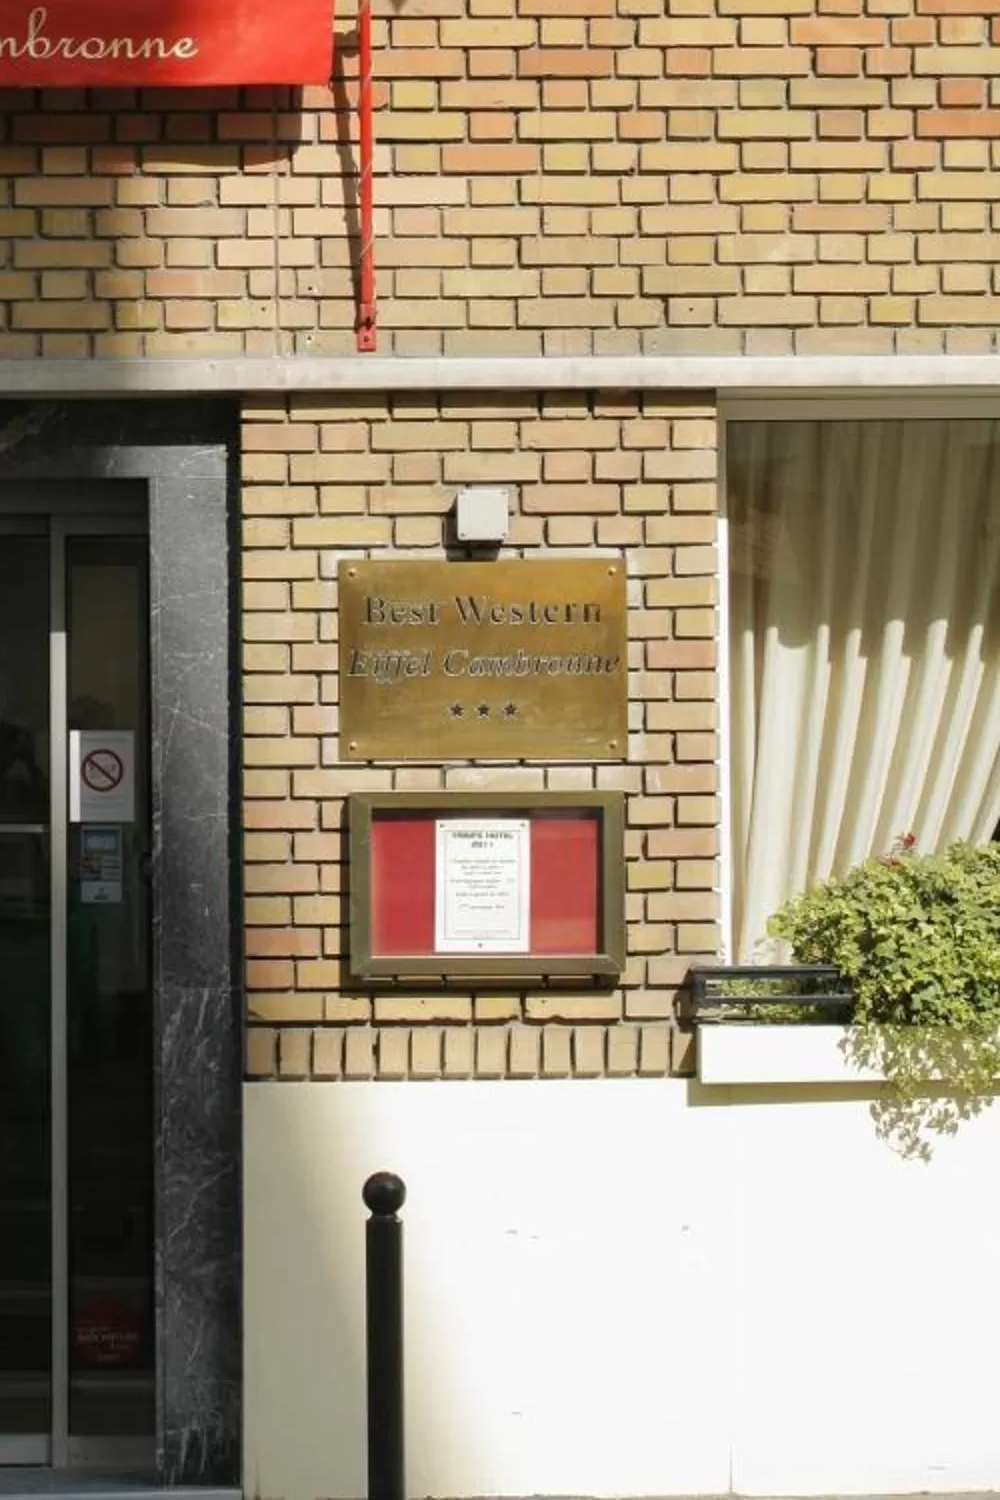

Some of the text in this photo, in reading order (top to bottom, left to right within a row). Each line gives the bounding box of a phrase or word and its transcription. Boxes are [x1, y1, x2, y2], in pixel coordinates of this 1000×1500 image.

[363, 595, 602, 625] Best Western
[348, 649, 621, 683] Eiffel Cambronne
